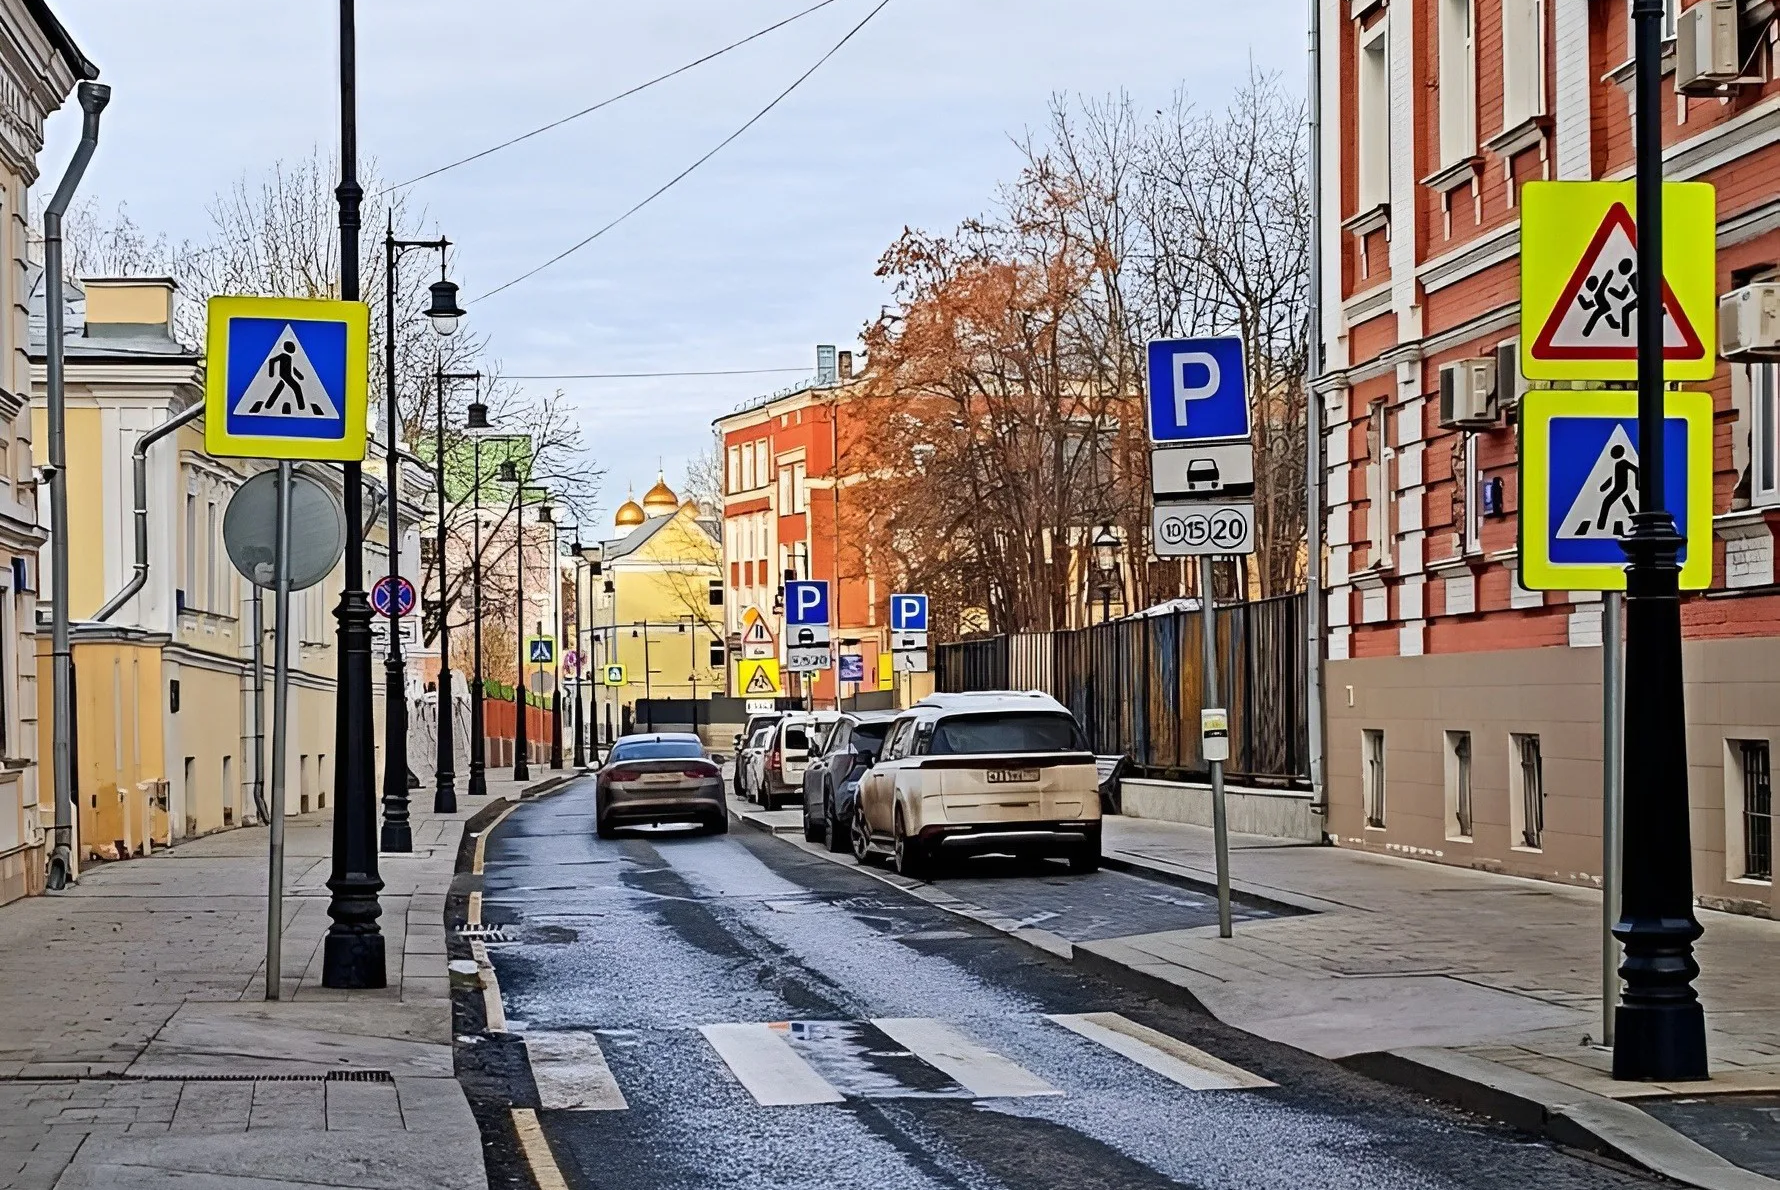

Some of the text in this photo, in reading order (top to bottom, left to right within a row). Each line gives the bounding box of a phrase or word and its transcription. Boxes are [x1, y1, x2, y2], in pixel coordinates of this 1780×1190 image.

[1172, 351, 1221, 427] P
[1165, 518, 1243, 540] 10 15 20
[797, 585, 821, 621] P
[901, 598, 920, 628] P
